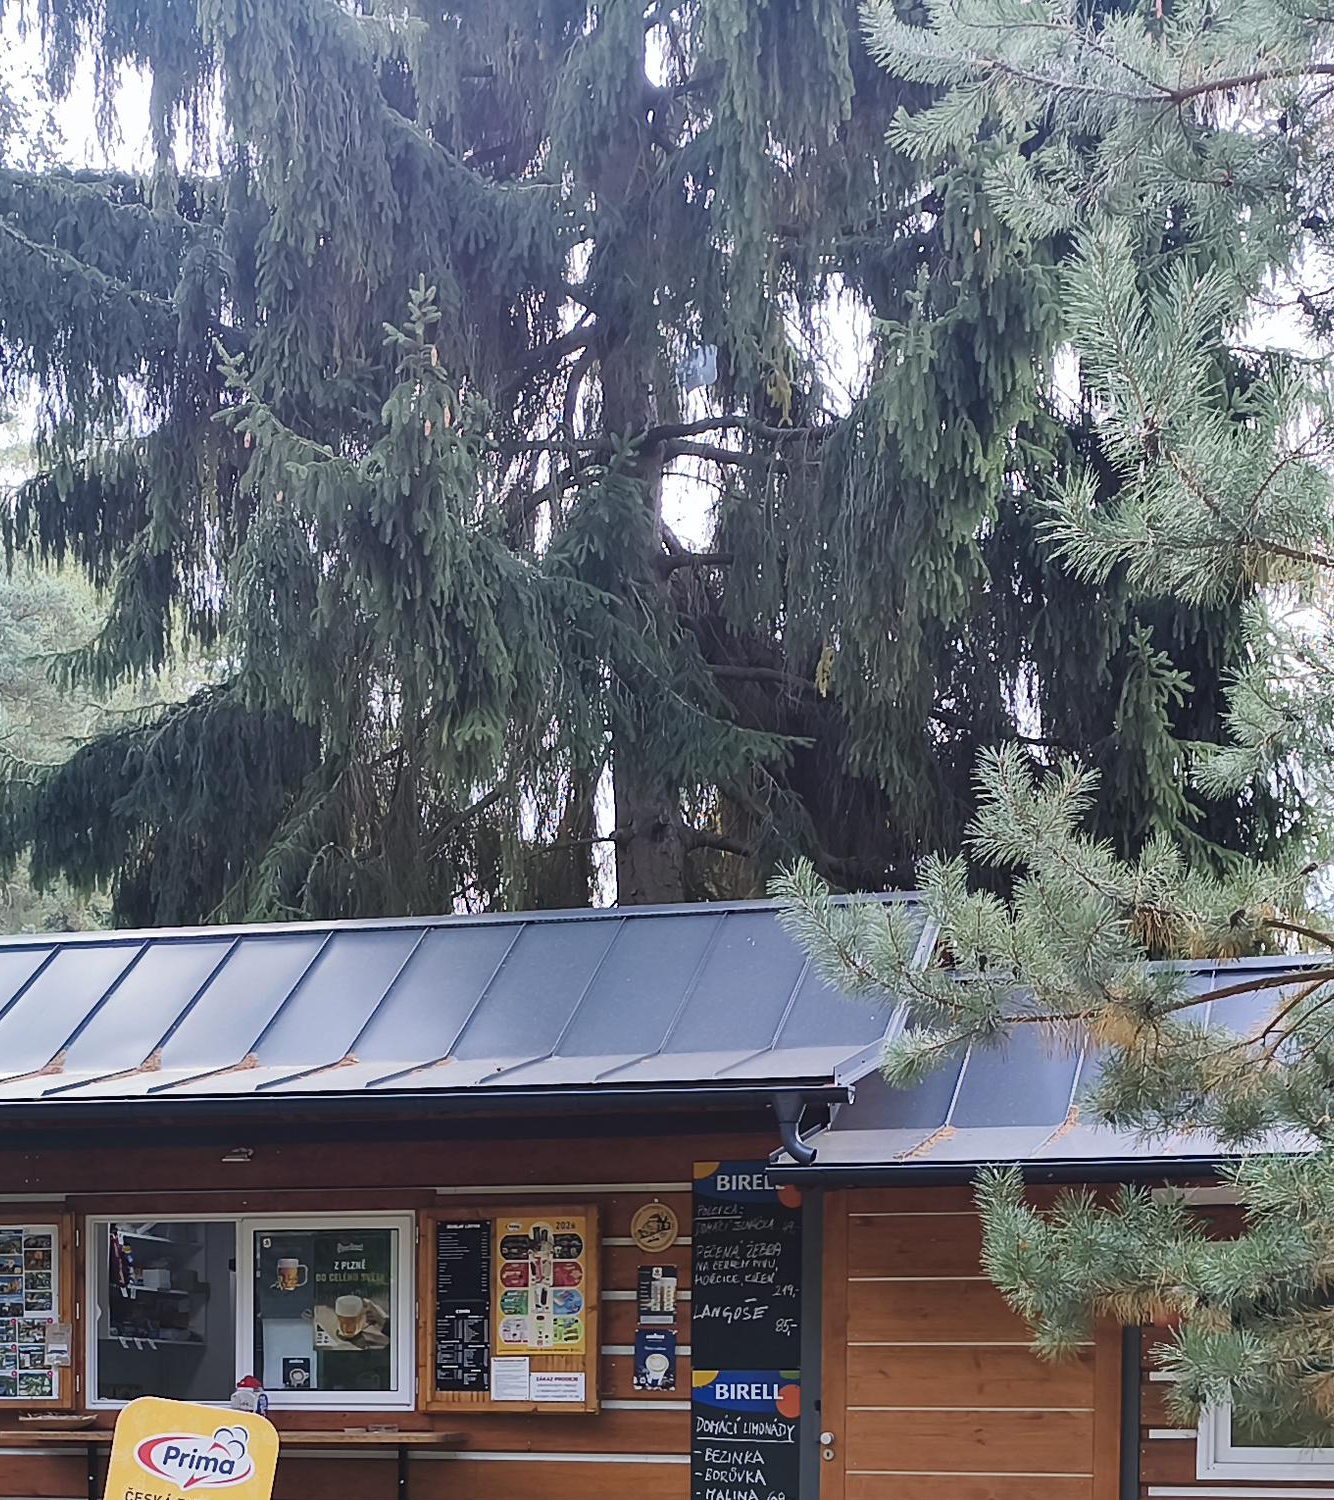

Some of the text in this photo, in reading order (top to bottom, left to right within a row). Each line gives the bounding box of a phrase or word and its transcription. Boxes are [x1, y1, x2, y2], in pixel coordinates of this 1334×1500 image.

[716, 1174, 785, 1191] BIREL
[715, 1383, 784, 1400] BIRELL
[696, 1414, 795, 1441] DOMÁCÍ LIMONÁDY
[162, 1445, 236, 1475] Prima
